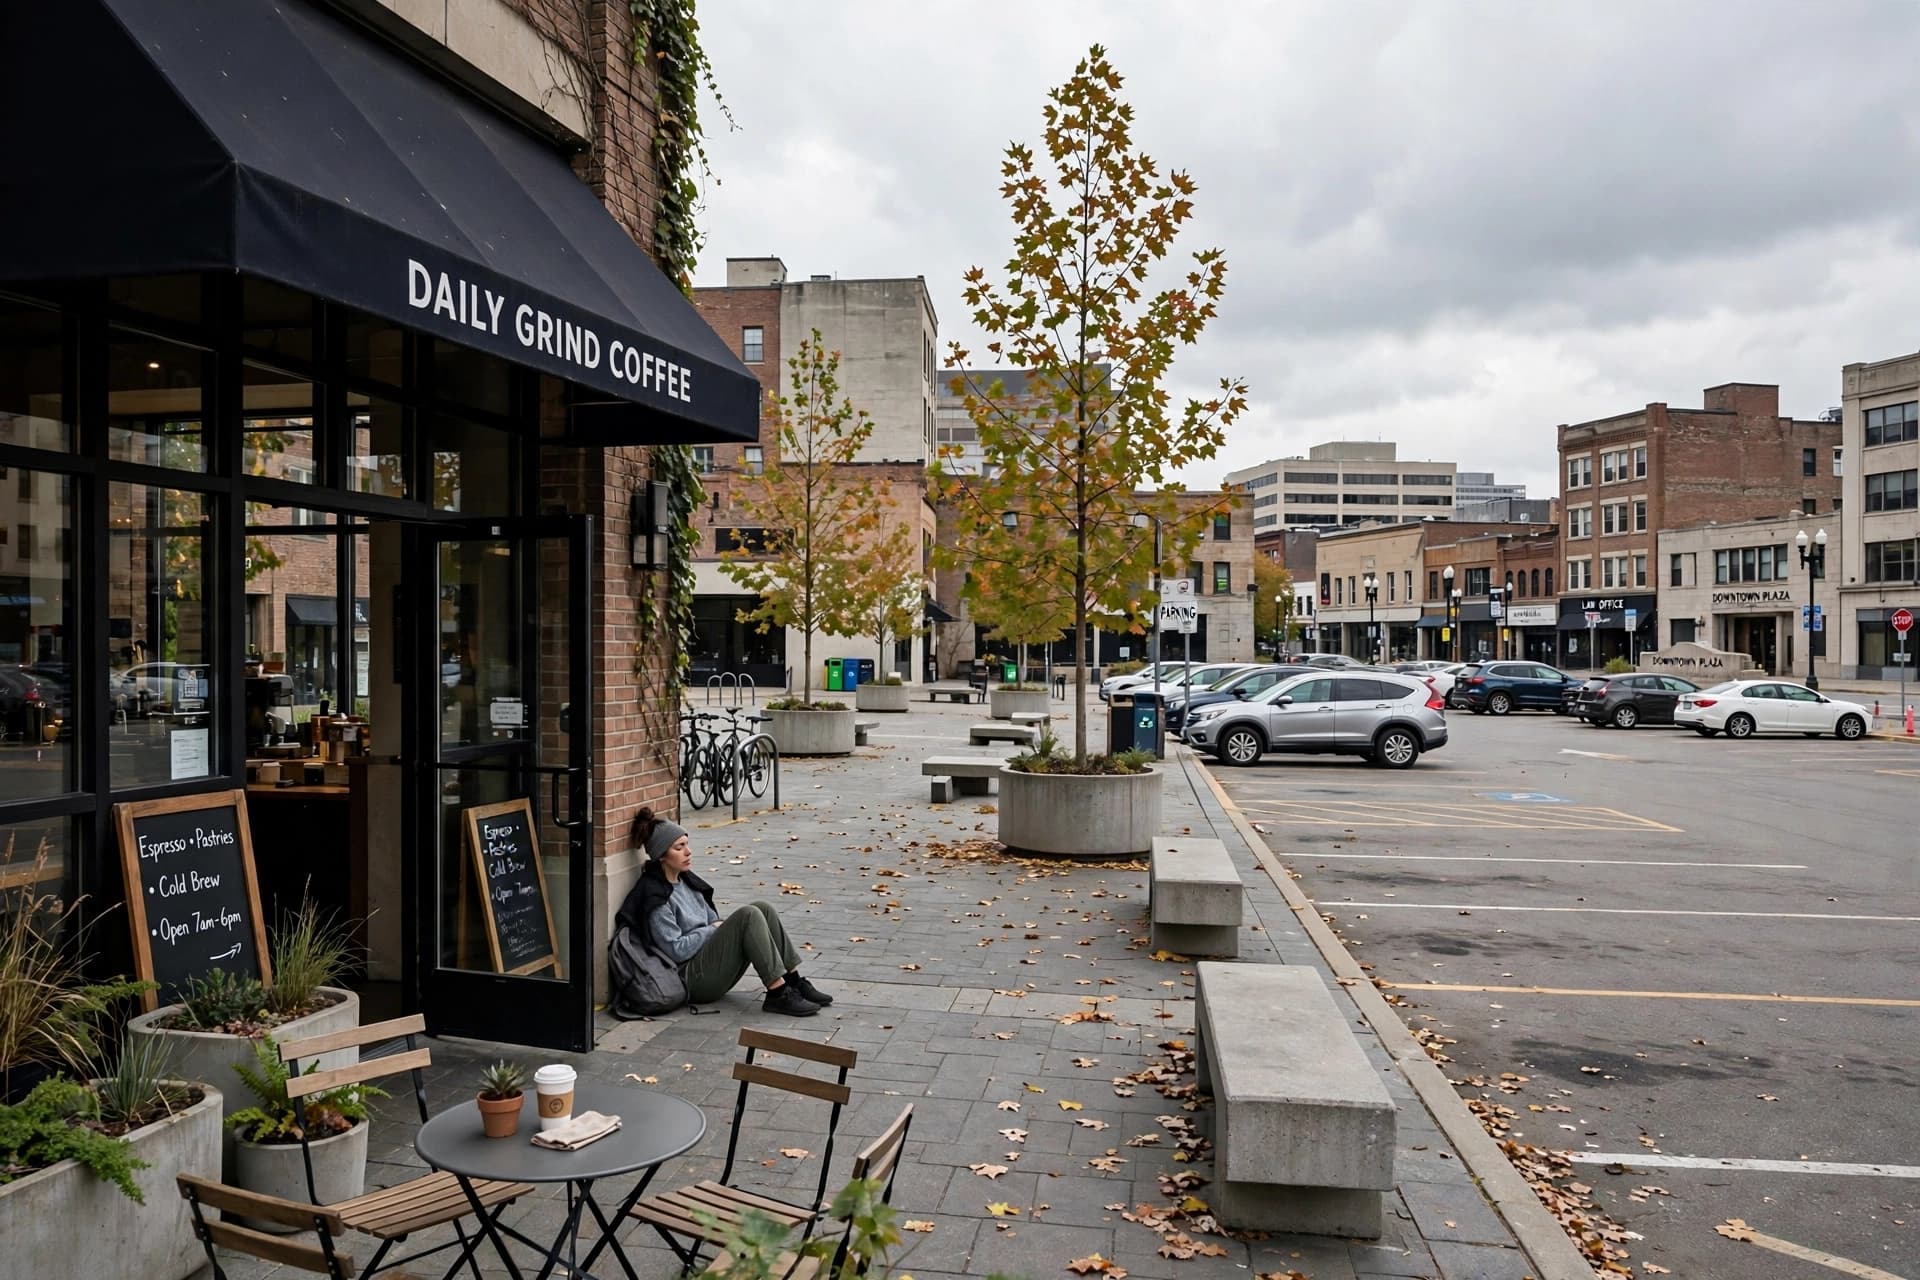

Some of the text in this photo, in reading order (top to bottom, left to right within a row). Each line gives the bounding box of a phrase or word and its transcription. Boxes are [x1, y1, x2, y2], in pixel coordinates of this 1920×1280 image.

[408, 258, 692, 403] DAILY GRIND COFFEE
[1598, 599, 1624, 610] OFFICE
[1712, 590, 1790, 603] DOWNTOWN PLAZA
[1893, 615, 1911, 625] STOP
[1699, 656, 1723, 668] PLAZA
[138, 827, 234, 863] Espresso Pastries
[159, 870, 220, 897] Cold Brew
[160, 906, 242, 946] Open 7am-6pm
